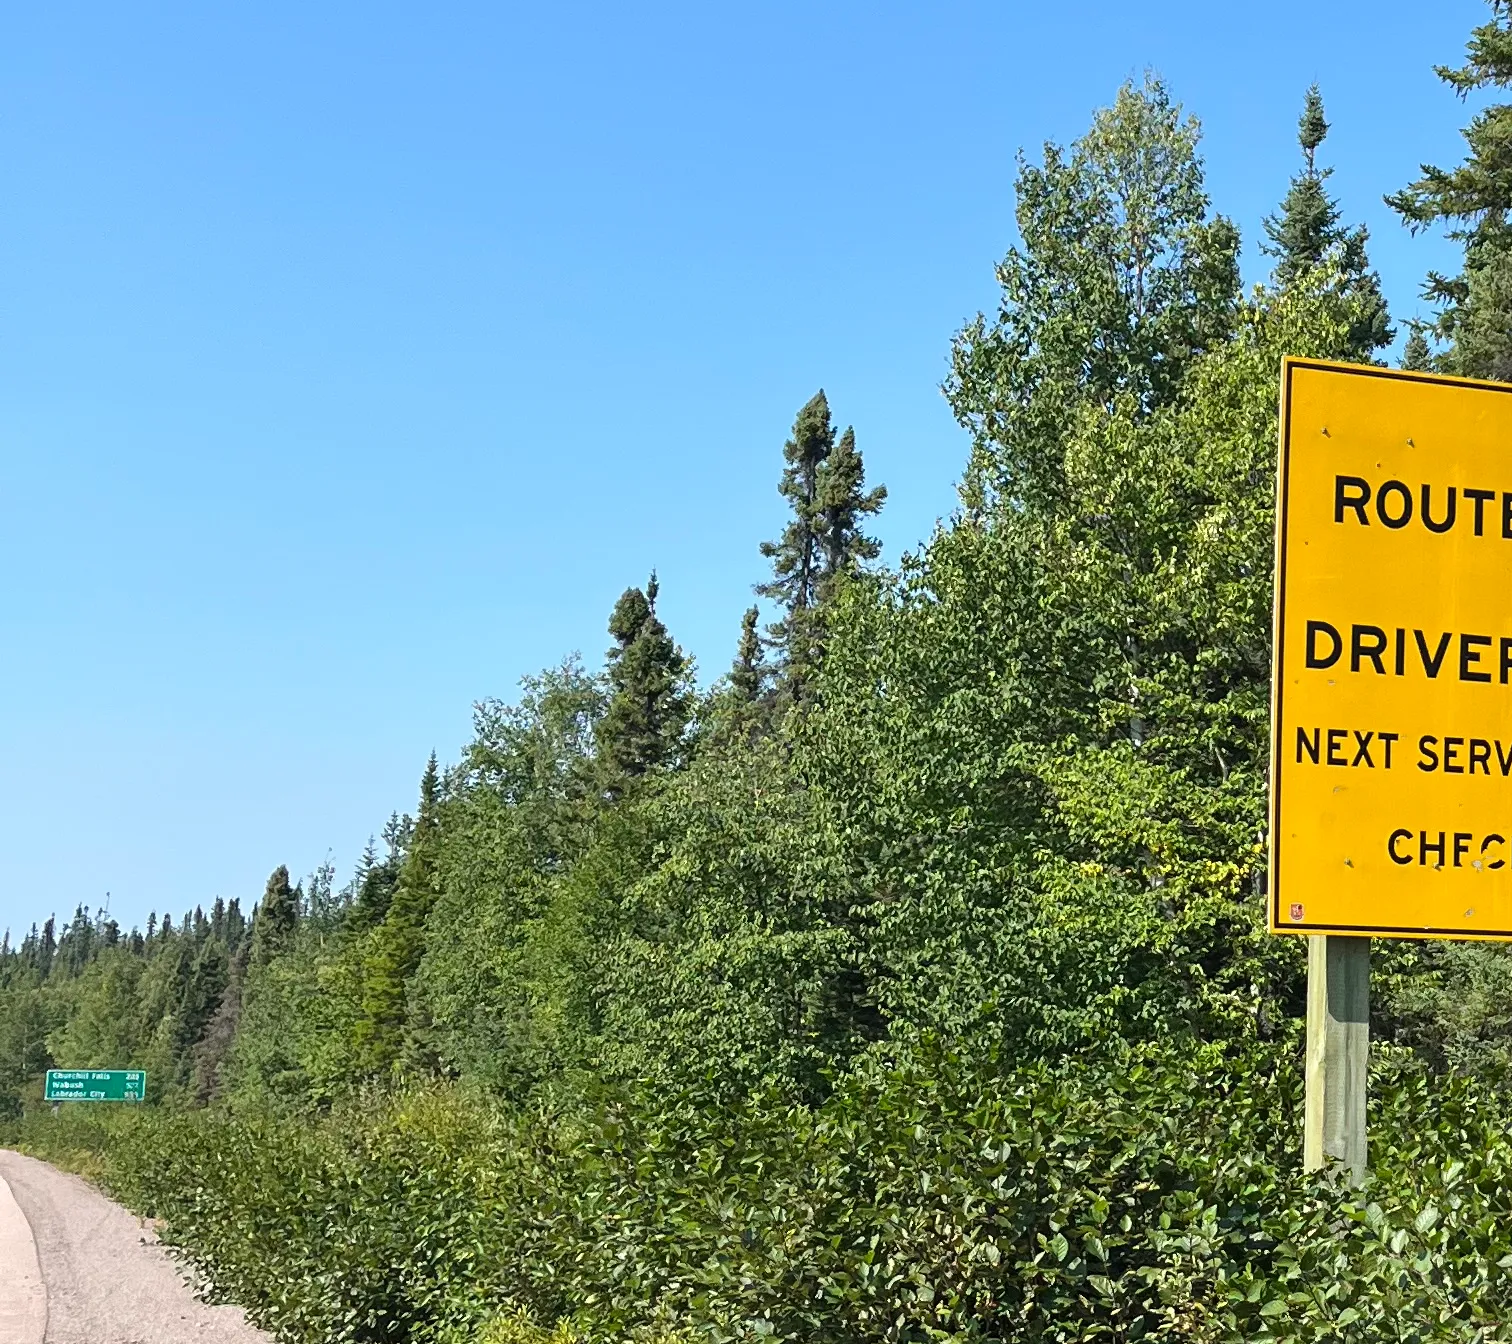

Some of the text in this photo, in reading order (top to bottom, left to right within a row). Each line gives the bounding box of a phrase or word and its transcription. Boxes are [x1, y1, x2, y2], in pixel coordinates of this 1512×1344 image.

[1296, 726, 1399, 769] NEXT
[51, 1090, 106, 1099] Labrador City
